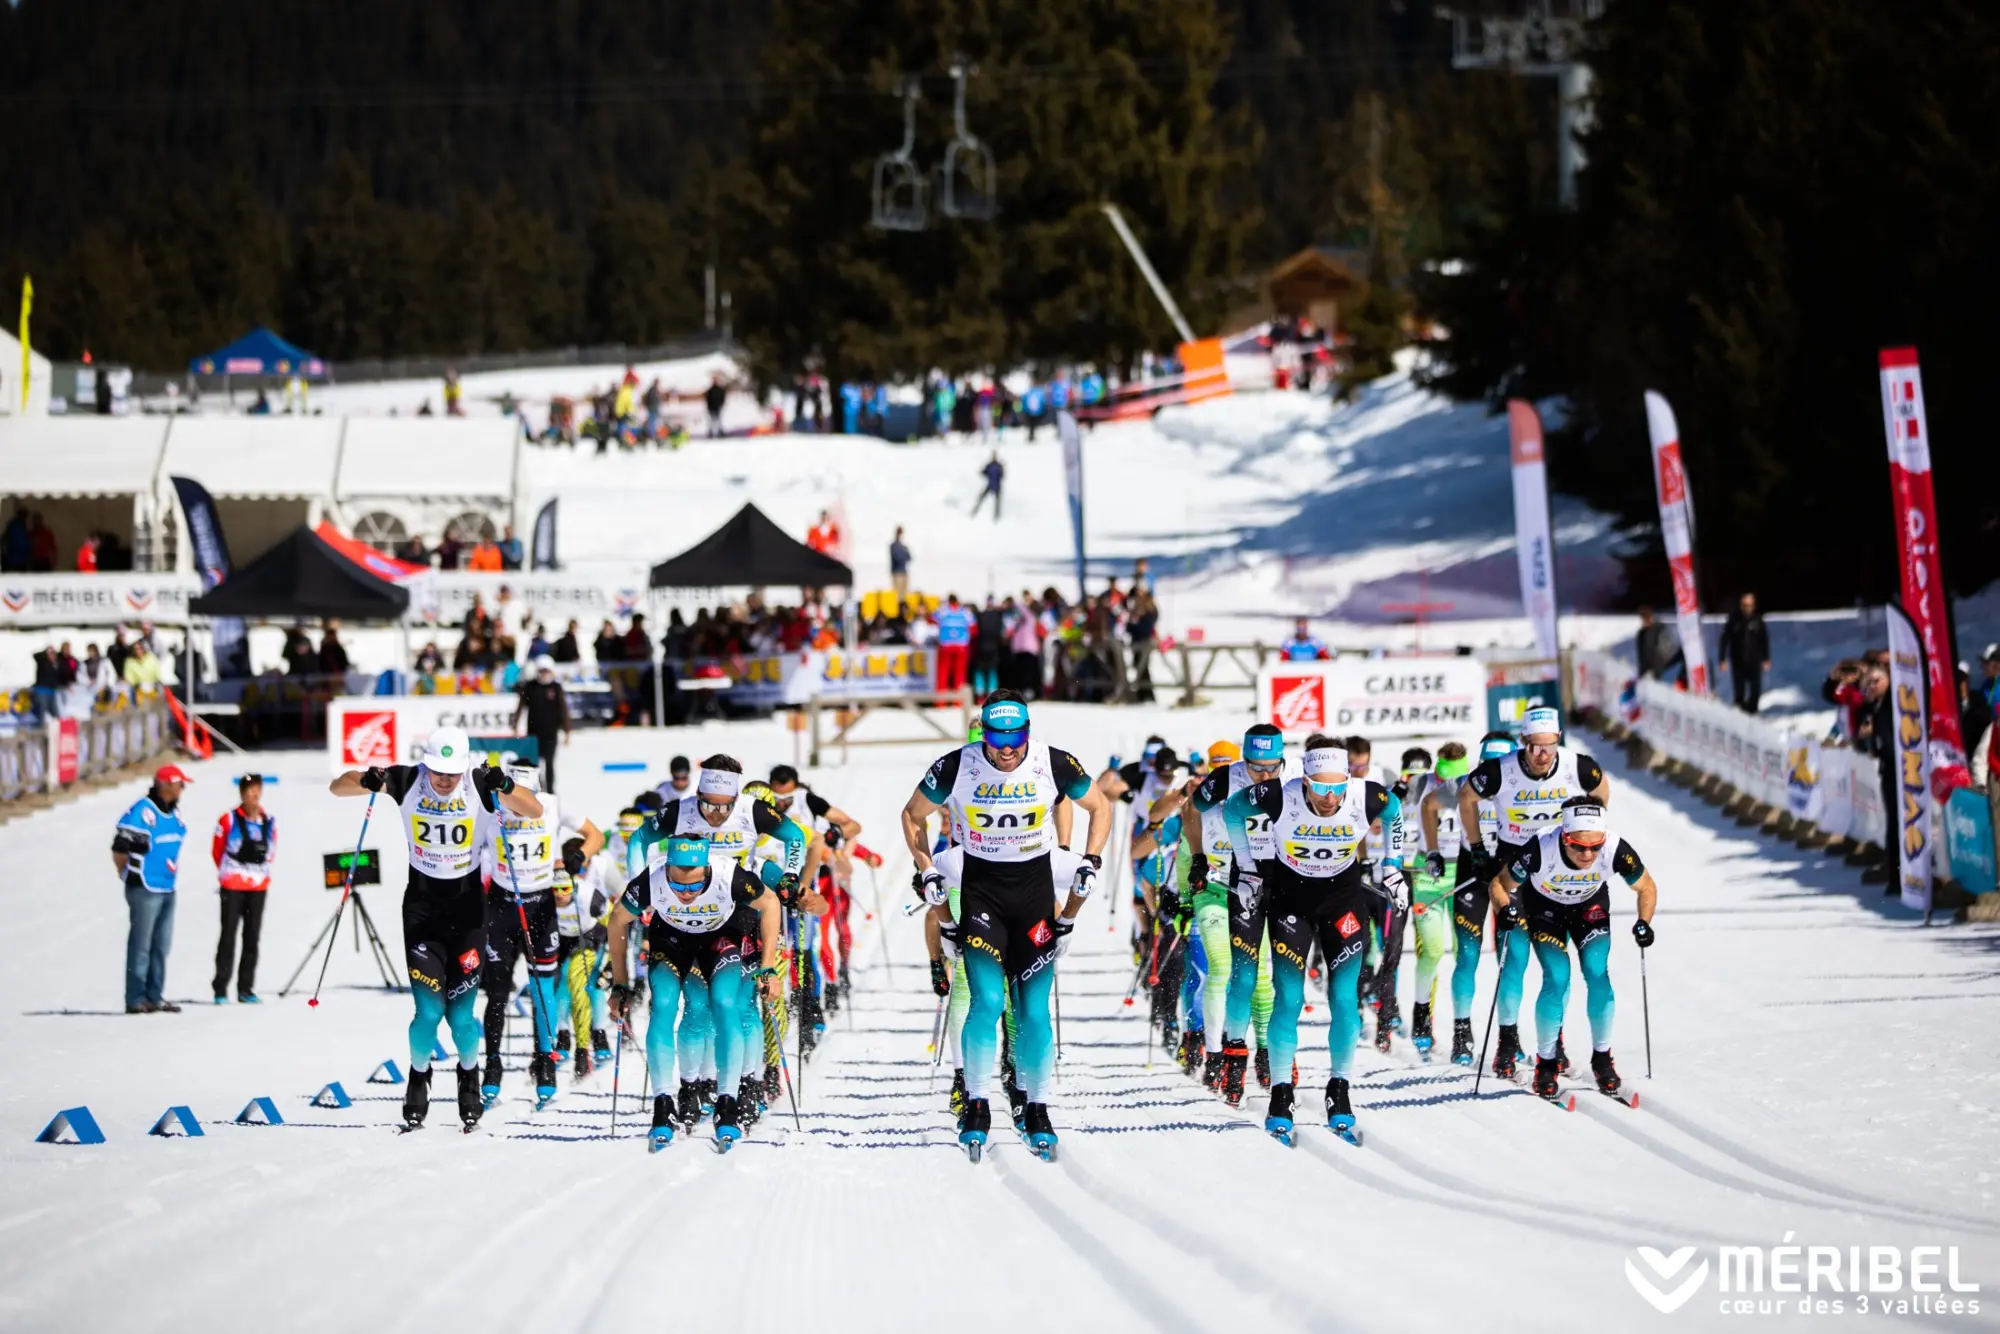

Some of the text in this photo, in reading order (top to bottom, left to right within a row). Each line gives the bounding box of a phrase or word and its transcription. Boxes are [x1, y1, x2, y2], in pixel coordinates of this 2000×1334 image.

[1366, 675, 1445, 694] CAISSE
[1338, 705, 1472, 725] D'EPARGNE
[974, 783, 1036, 798] SAMSE
[417, 796, 467, 812] SAMSE
[976, 812, 1036, 828] 201
[1293, 824, 1355, 837] SAMSE
[417, 821, 467, 845] 210
[1393, 813, 1403, 850] FRAN
[675, 843, 706, 853] somfy
[1294, 846, 1351, 860] 203
[966, 935, 1002, 962] somfy
[1272, 939, 1304, 970] somfy
[1330, 941, 1362, 970] odlo
[1021, 949, 1055, 980] odlo
[409, 967, 442, 992] somfy
[447, 975, 480, 1000] odlo
